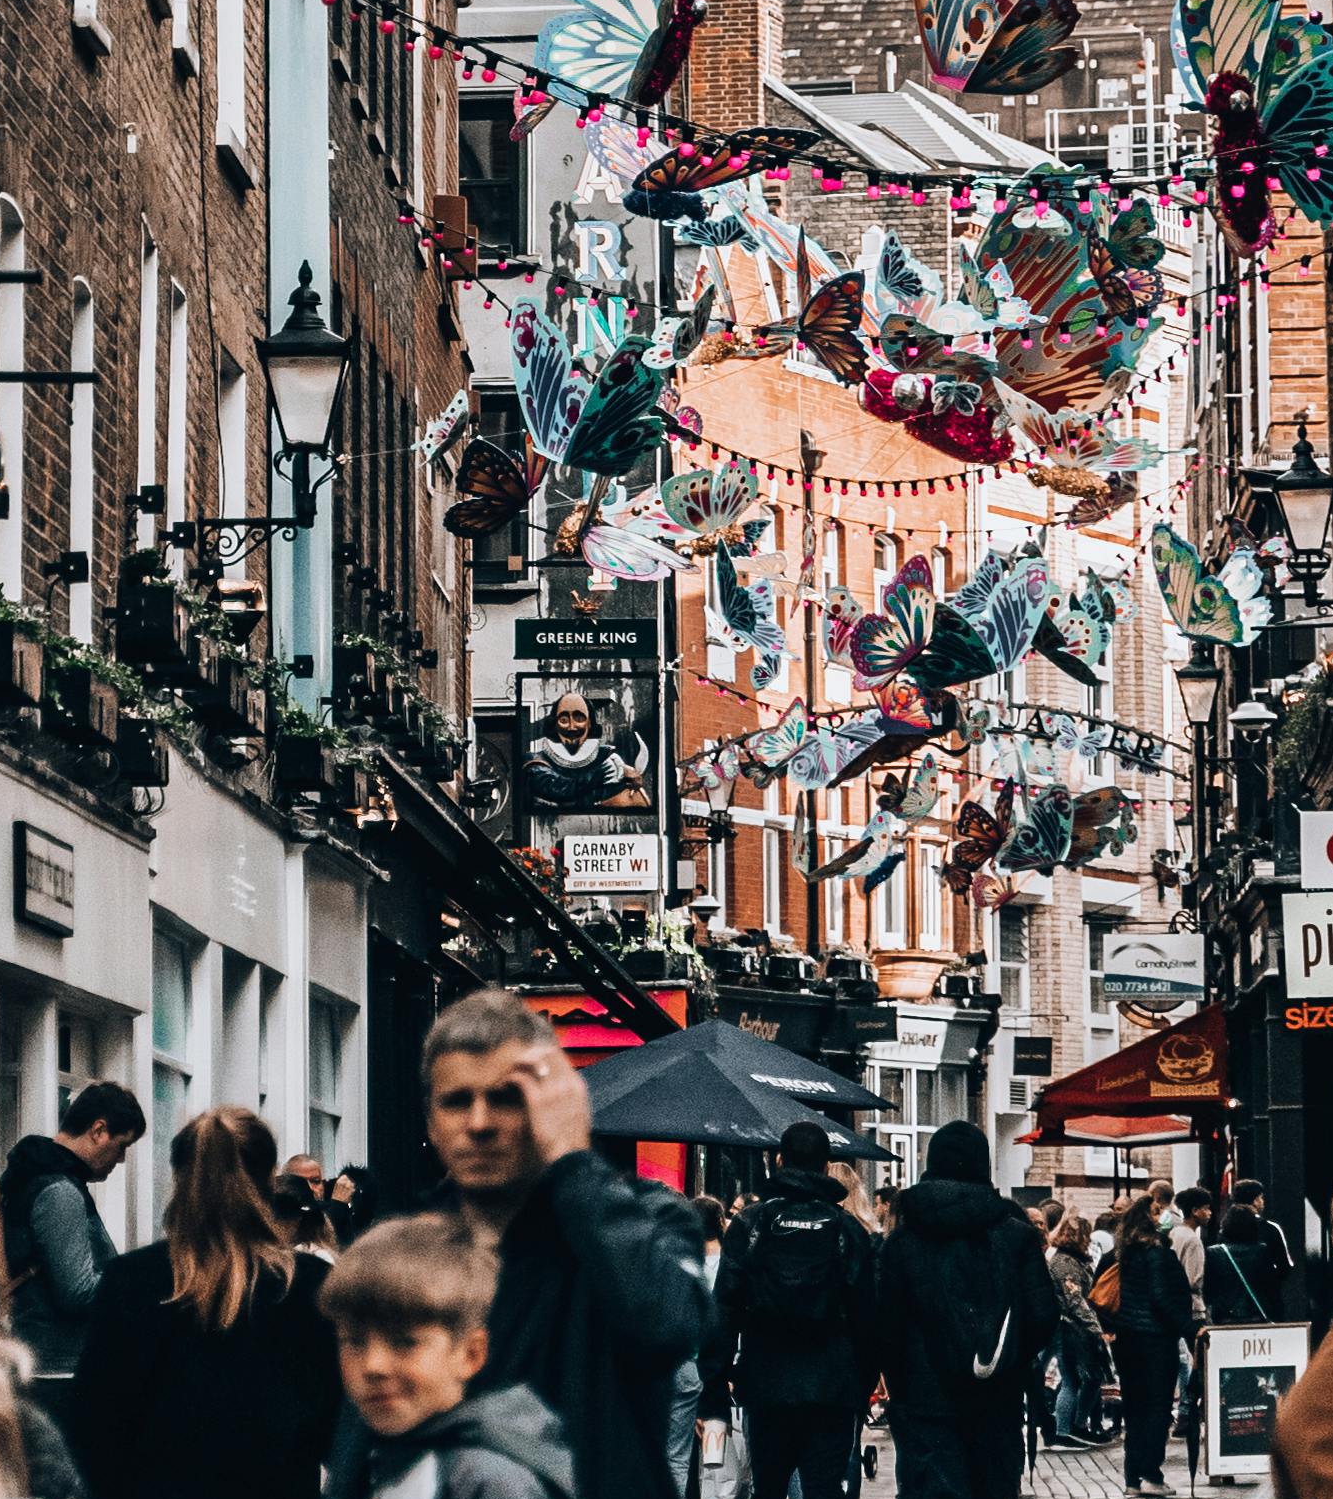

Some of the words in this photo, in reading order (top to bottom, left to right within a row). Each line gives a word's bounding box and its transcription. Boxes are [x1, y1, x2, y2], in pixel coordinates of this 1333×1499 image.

[536, 632, 594, 644] GREENE
[599, 632, 637, 644] KING
[573, 843, 635, 856] CARNABY
[574, 859, 622, 872] STREET
[630, 859, 649, 872] W1
[1104, 982, 1123, 992] 020
[1125, 982, 1148, 991] 7734
[1150, 982, 1171, 991] 6421
